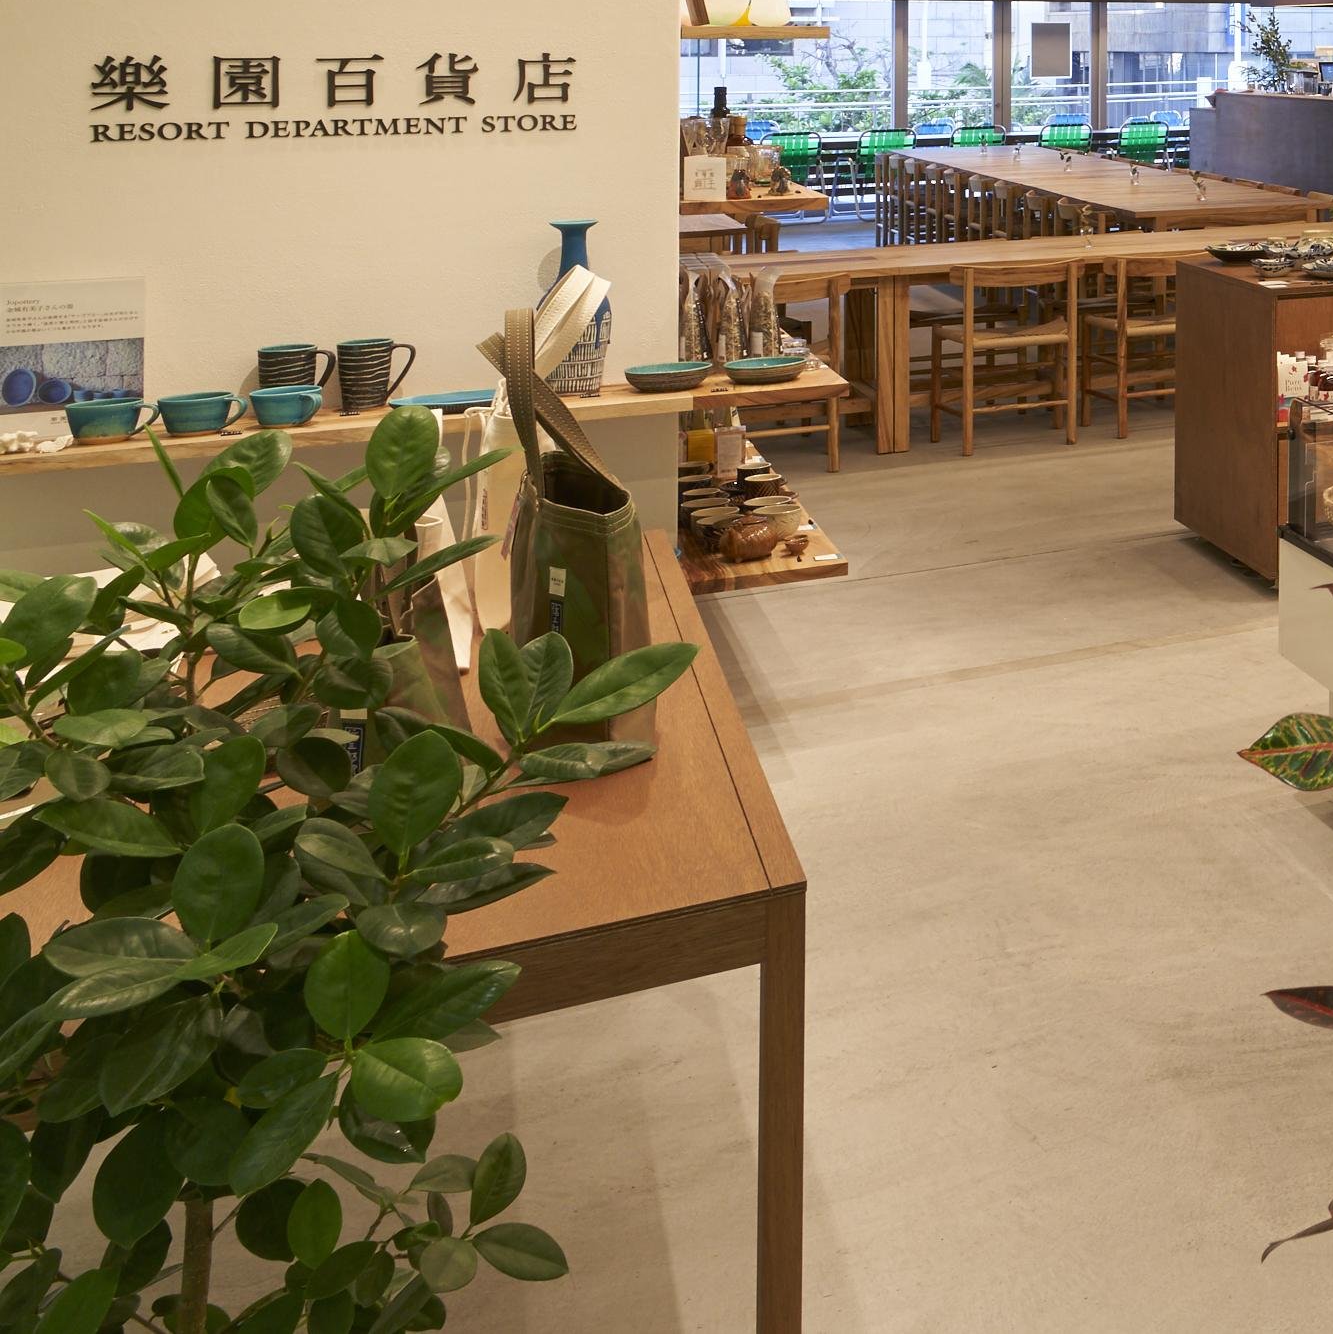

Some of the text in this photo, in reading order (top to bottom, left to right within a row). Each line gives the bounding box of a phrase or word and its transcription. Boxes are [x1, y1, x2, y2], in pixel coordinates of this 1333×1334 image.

[90, 52, 577, 111] 樂園百貨店
[90, 112, 578, 143] RESORT DEPARTMENT STORE
